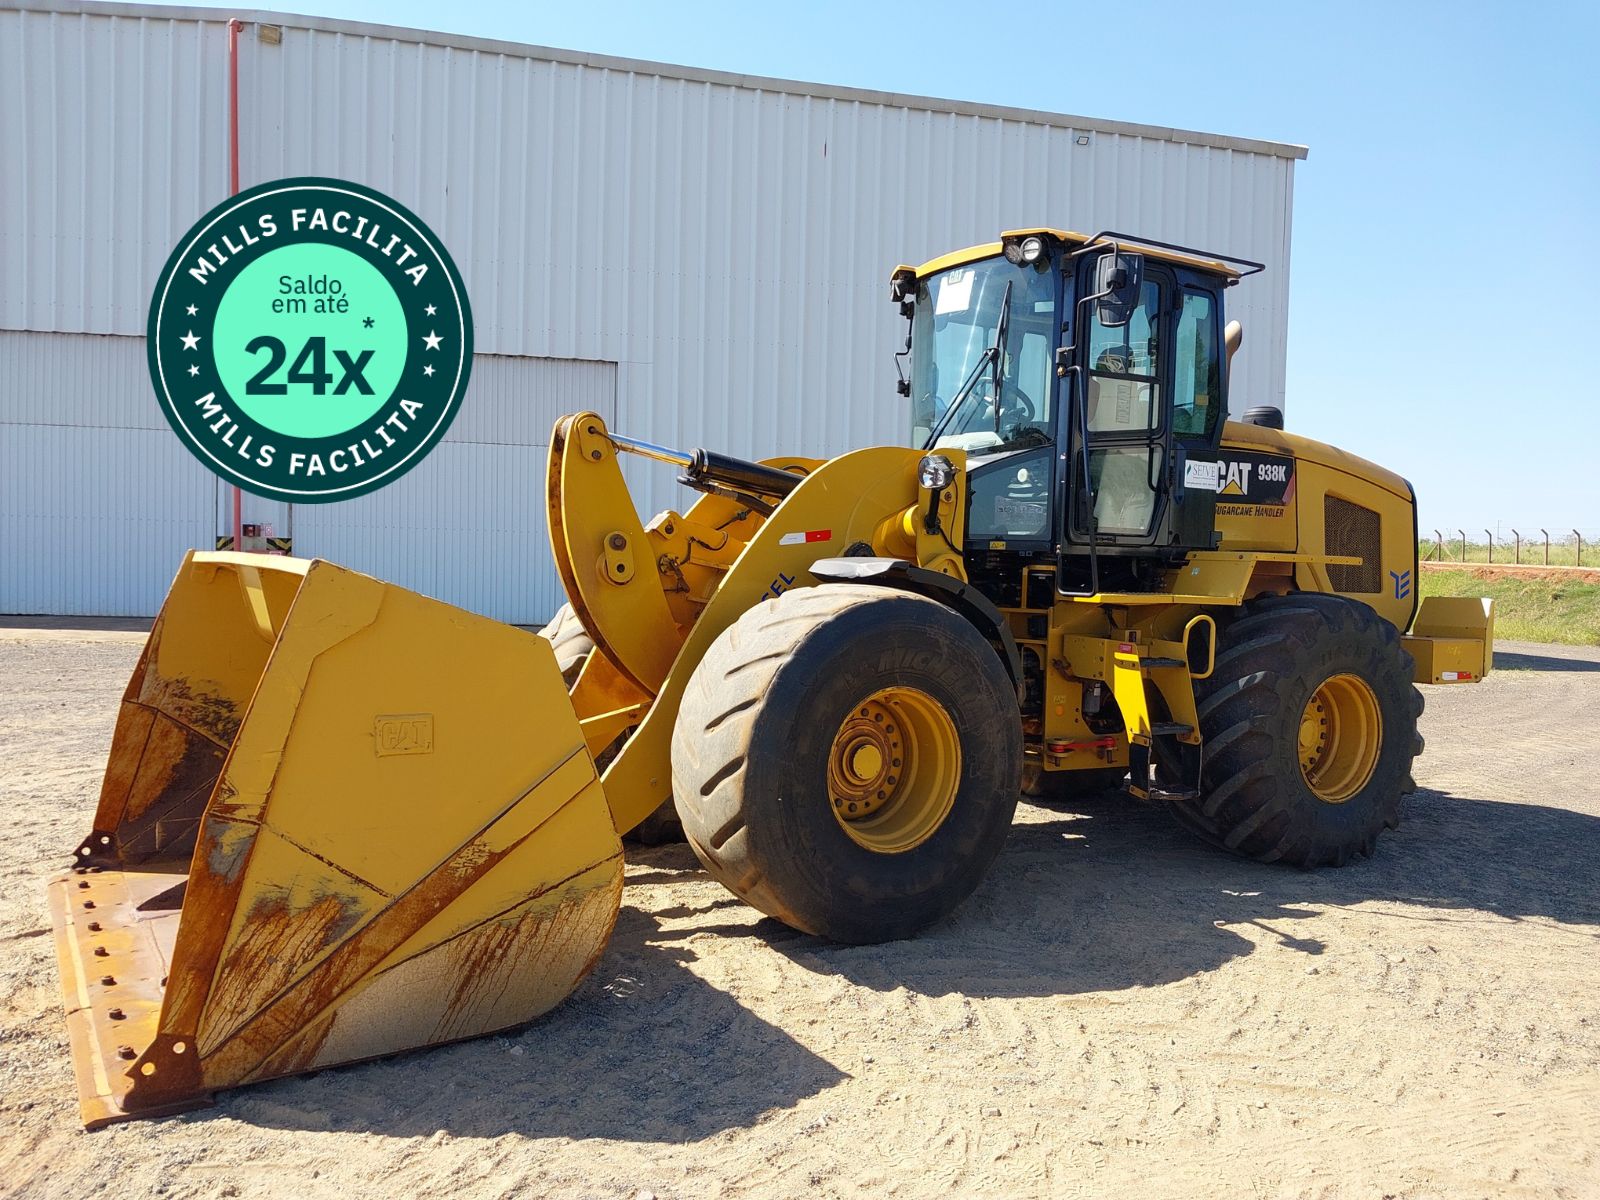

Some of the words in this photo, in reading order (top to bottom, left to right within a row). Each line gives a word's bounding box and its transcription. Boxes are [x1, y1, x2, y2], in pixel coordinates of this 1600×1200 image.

[1216, 460, 1252, 496] CAT
[1258, 464, 1287, 482] 938K
[1254, 505, 1284, 518] HANDLER
[381, 720, 428, 750] CAT
